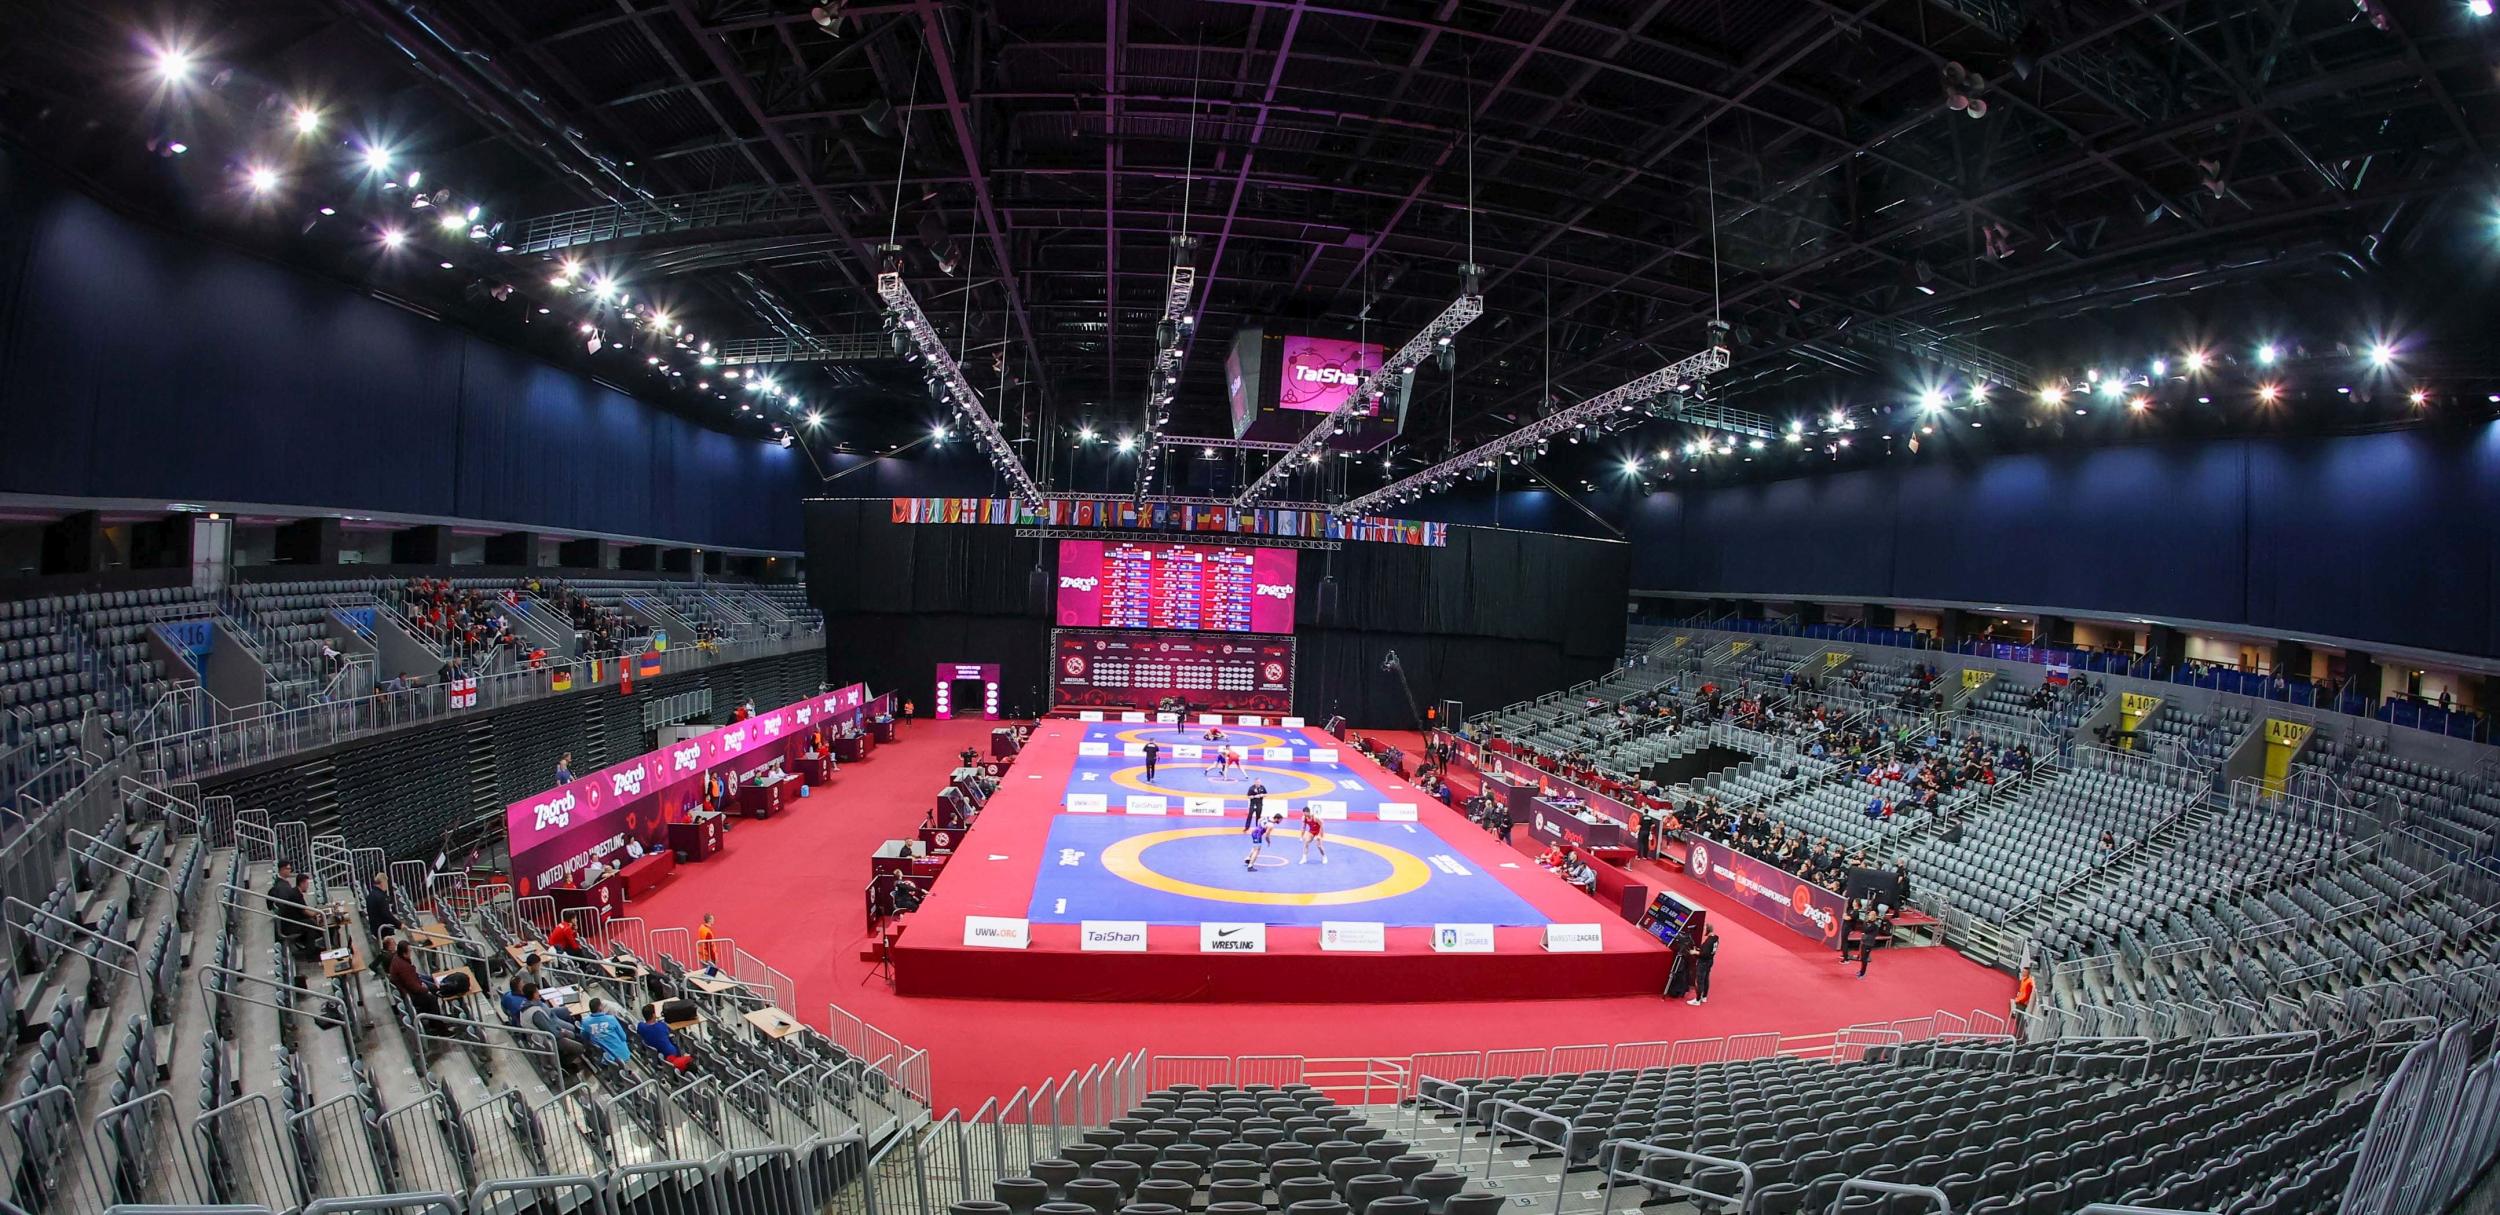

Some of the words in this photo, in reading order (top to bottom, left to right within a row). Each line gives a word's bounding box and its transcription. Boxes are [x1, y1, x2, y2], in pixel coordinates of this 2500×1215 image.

[1060, 576, 1098, 589] Zagreb
[1256, 584, 1294, 597] Zagreb
[2127, 695, 2134, 708] A
[2272, 722, 2280, 736] A
[613, 763, 645, 796] Zagreb
[534, 790, 576, 831] Zagreb
[537, 864, 563, 890] UNITED
[563, 850, 589, 874] WORLD
[1803, 903, 1832, 924] Zagreb
[975, 928, 1017, 938] UWW.ORG
[1088, 930, 1140, 943] TaiShan
[1211, 940, 1254, 950] WRESTLING
